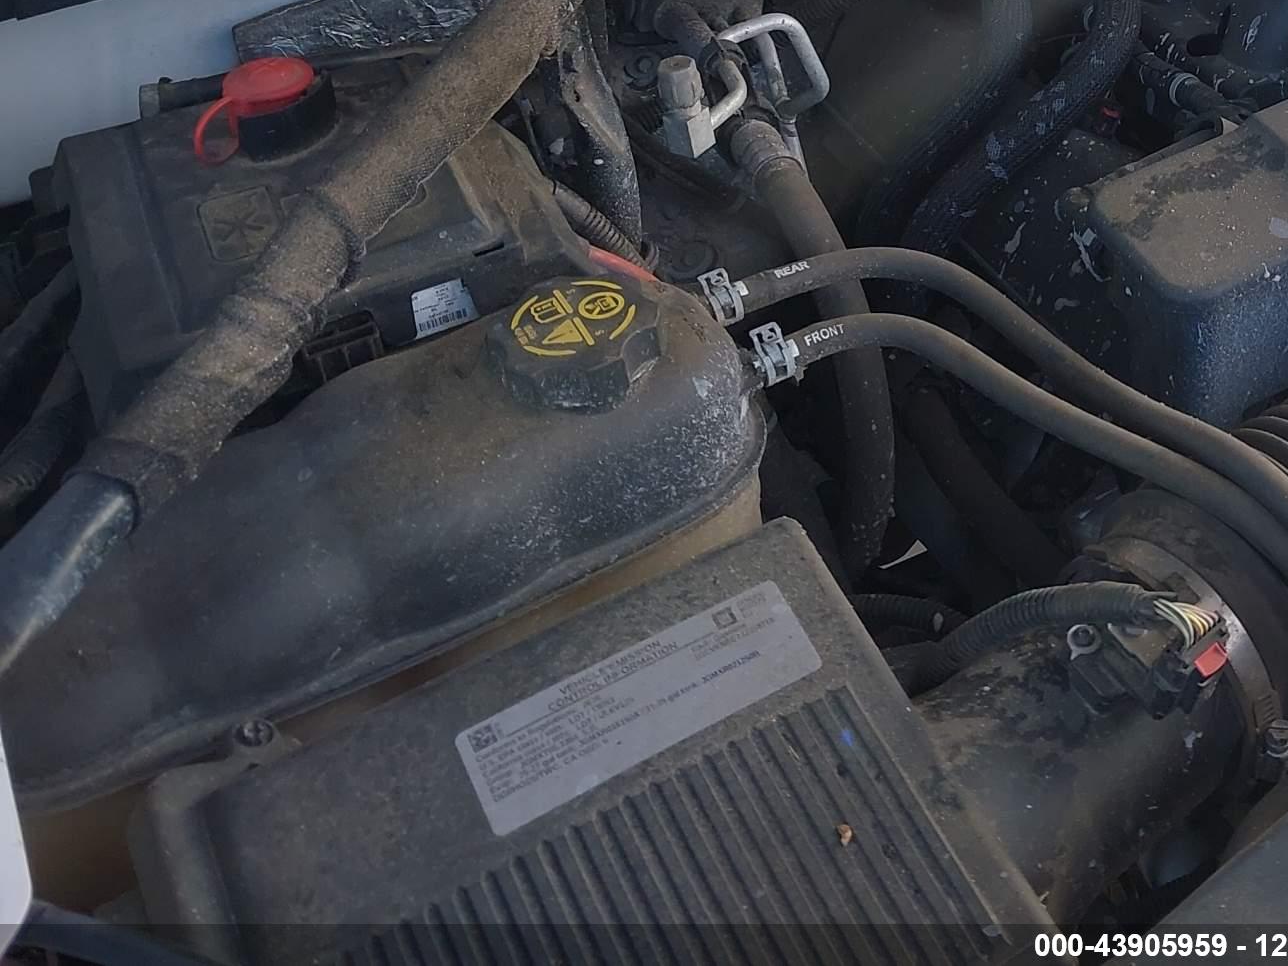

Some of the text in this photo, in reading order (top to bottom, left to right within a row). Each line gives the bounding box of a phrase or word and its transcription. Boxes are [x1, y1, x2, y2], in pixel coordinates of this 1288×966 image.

[774, 261, 810, 278] REAR
[804, 324, 845, 346] FRONT
[558, 666, 604, 695] VEHICLE
[546, 678, 602, 712] CONTROL
